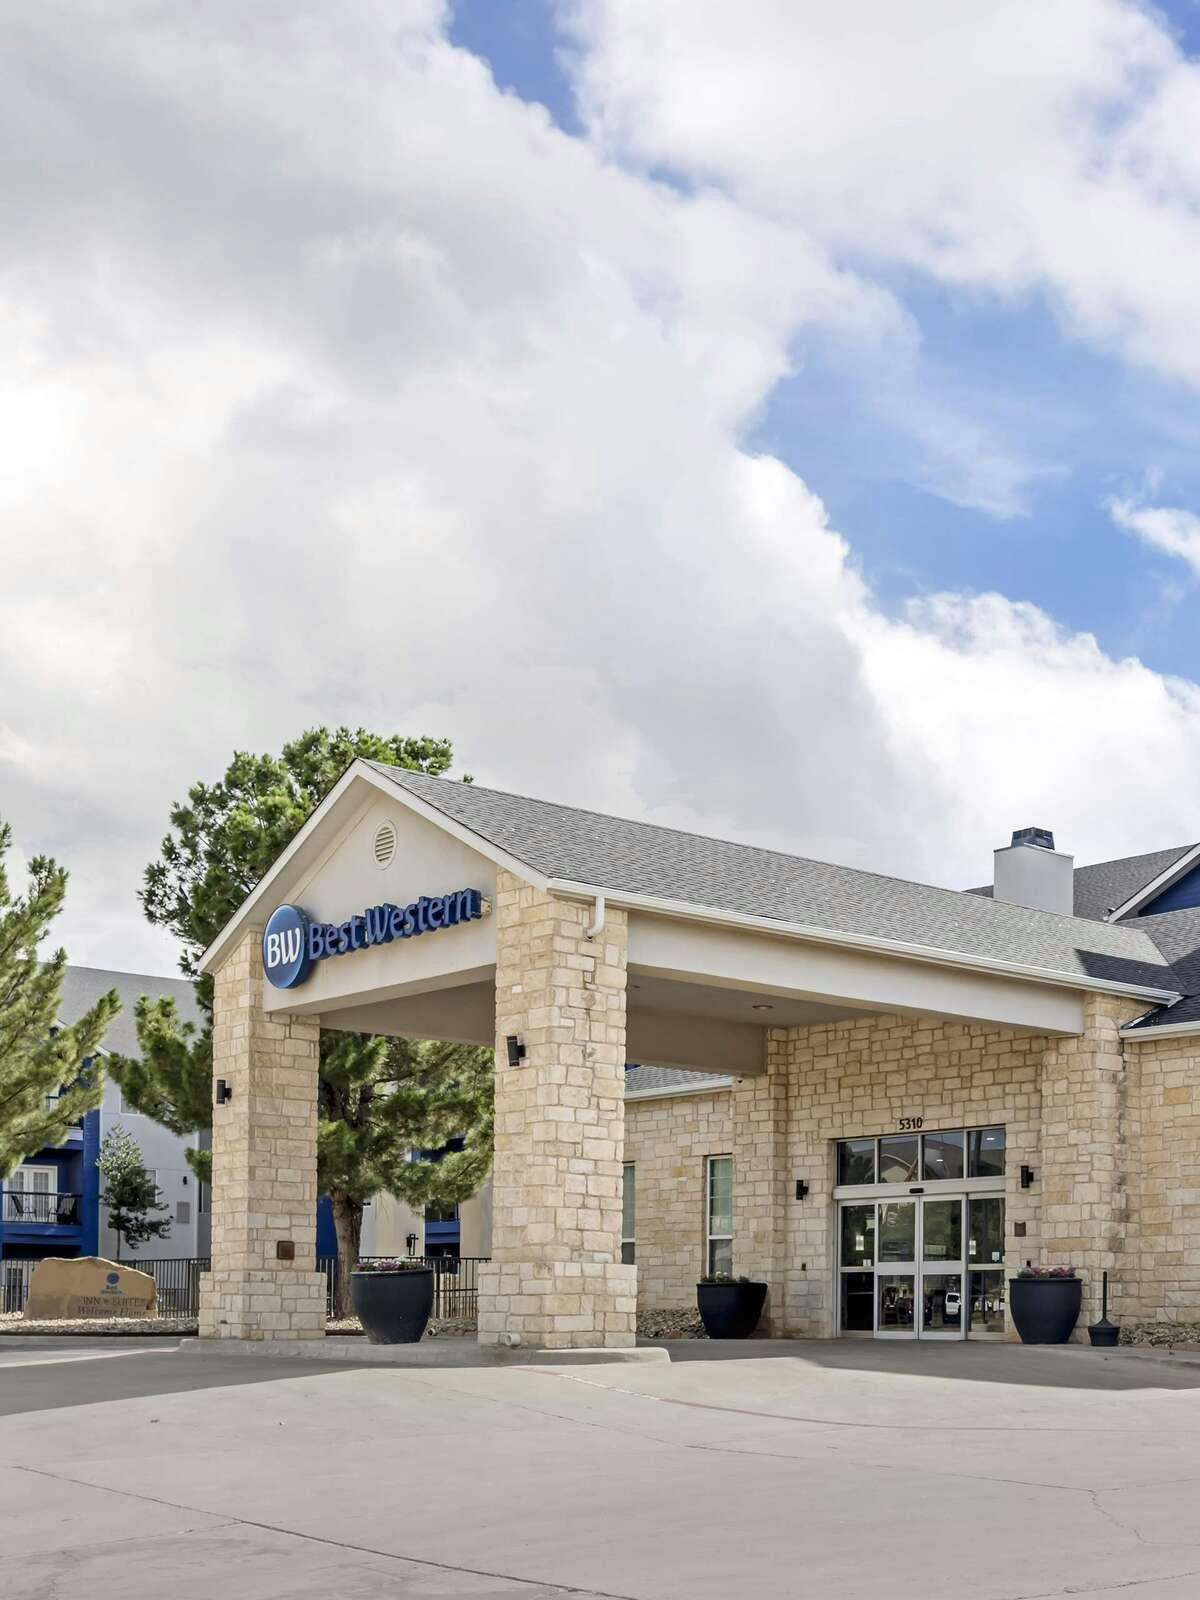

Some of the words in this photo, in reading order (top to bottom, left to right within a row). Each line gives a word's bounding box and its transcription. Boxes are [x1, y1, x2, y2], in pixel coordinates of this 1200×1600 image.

[267, 927, 300, 968] BW
[308, 915, 367, 960] Best
[365, 888, 482, 945] Western
[899, 1116, 923, 1130] 5310
